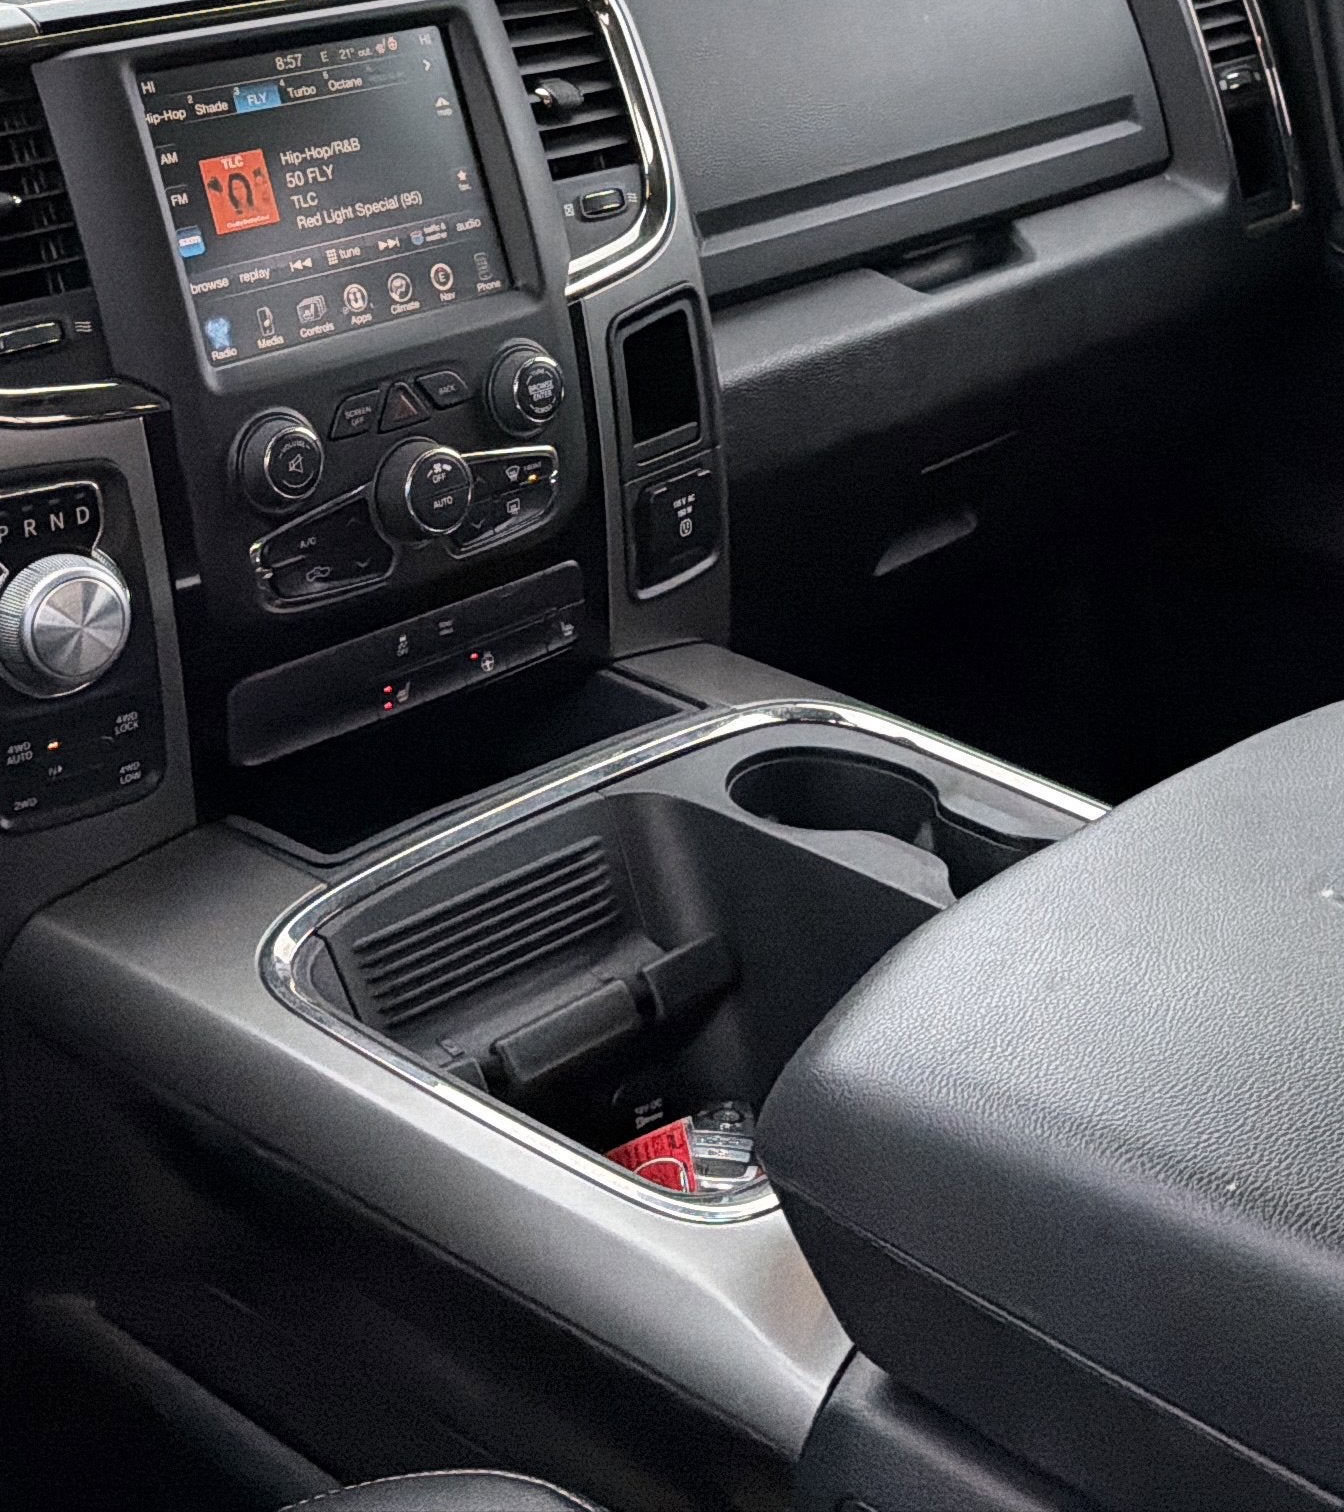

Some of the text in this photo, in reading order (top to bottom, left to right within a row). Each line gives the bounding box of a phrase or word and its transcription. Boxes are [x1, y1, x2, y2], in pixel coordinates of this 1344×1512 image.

[419, 33, 432, 46] HI
[275, 53, 303, 71] 8:57
[320, 51, 329, 63] E
[140, 81, 156, 95] HI
[286, 84, 317, 99] Turbo
[327, 77, 363, 92] Octane
[247, 92, 268, 107] FLY
[194, 100, 229, 116] Shade
[160, 151, 179, 166] AM
[280, 137, 361, 166] Hip-Hop/R&B
[220, 154, 244, 171] TLC
[285, 164, 334, 188] 50 FLY
[170, 192, 189, 207] FM
[290, 191, 319, 209] TLC
[296, 190, 423, 230] Red Light Special (95)
[455, 217, 482, 232] audio
[338, 245, 362, 260] tune
[239, 267, 272, 284] replay
[189, 276, 230, 296] browse
[476, 279, 502, 293] Phone
[439, 291, 456, 302] Nav
[390, 299, 421, 315] Climate
[350, 311, 373, 326] Apps
[299, 321, 336, 338] Controls
[257, 334, 285, 350] Media
[211, 347, 238, 362] Radio
[432, 471, 447, 484] OFF
[433, 495, 453, 509] AUTO
[23, 518, 38, 539] R
[48, 510, 65, 533] N
[75, 505, 90, 526] D
[299, 536, 317, 549] A/C
[115, 710, 139, 725] 4WD
[114, 720, 140, 736] LOCK
[6, 740, 32, 755] 4WD
[6, 750, 34, 766] AUTO
[119, 760, 141, 774] 4WD
[119, 770, 142, 785] LOW
[13, 796, 39, 811] 2WD
